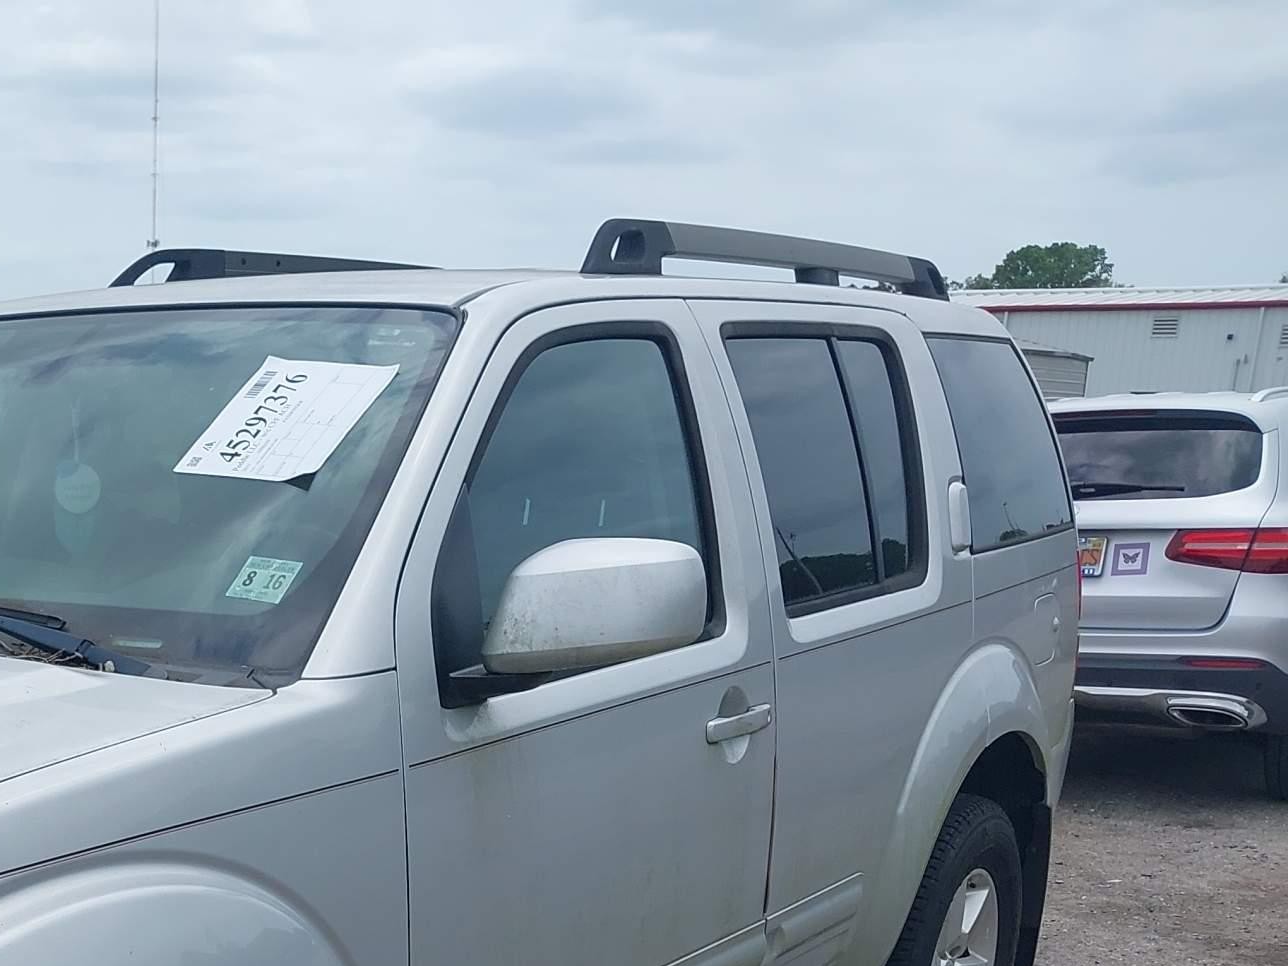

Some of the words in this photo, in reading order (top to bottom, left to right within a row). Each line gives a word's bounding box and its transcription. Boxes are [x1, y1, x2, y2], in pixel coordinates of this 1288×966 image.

[219, 373, 308, 463] 45297376
[242, 570, 258, 587] 8
[262, 573, 287, 590] 16
